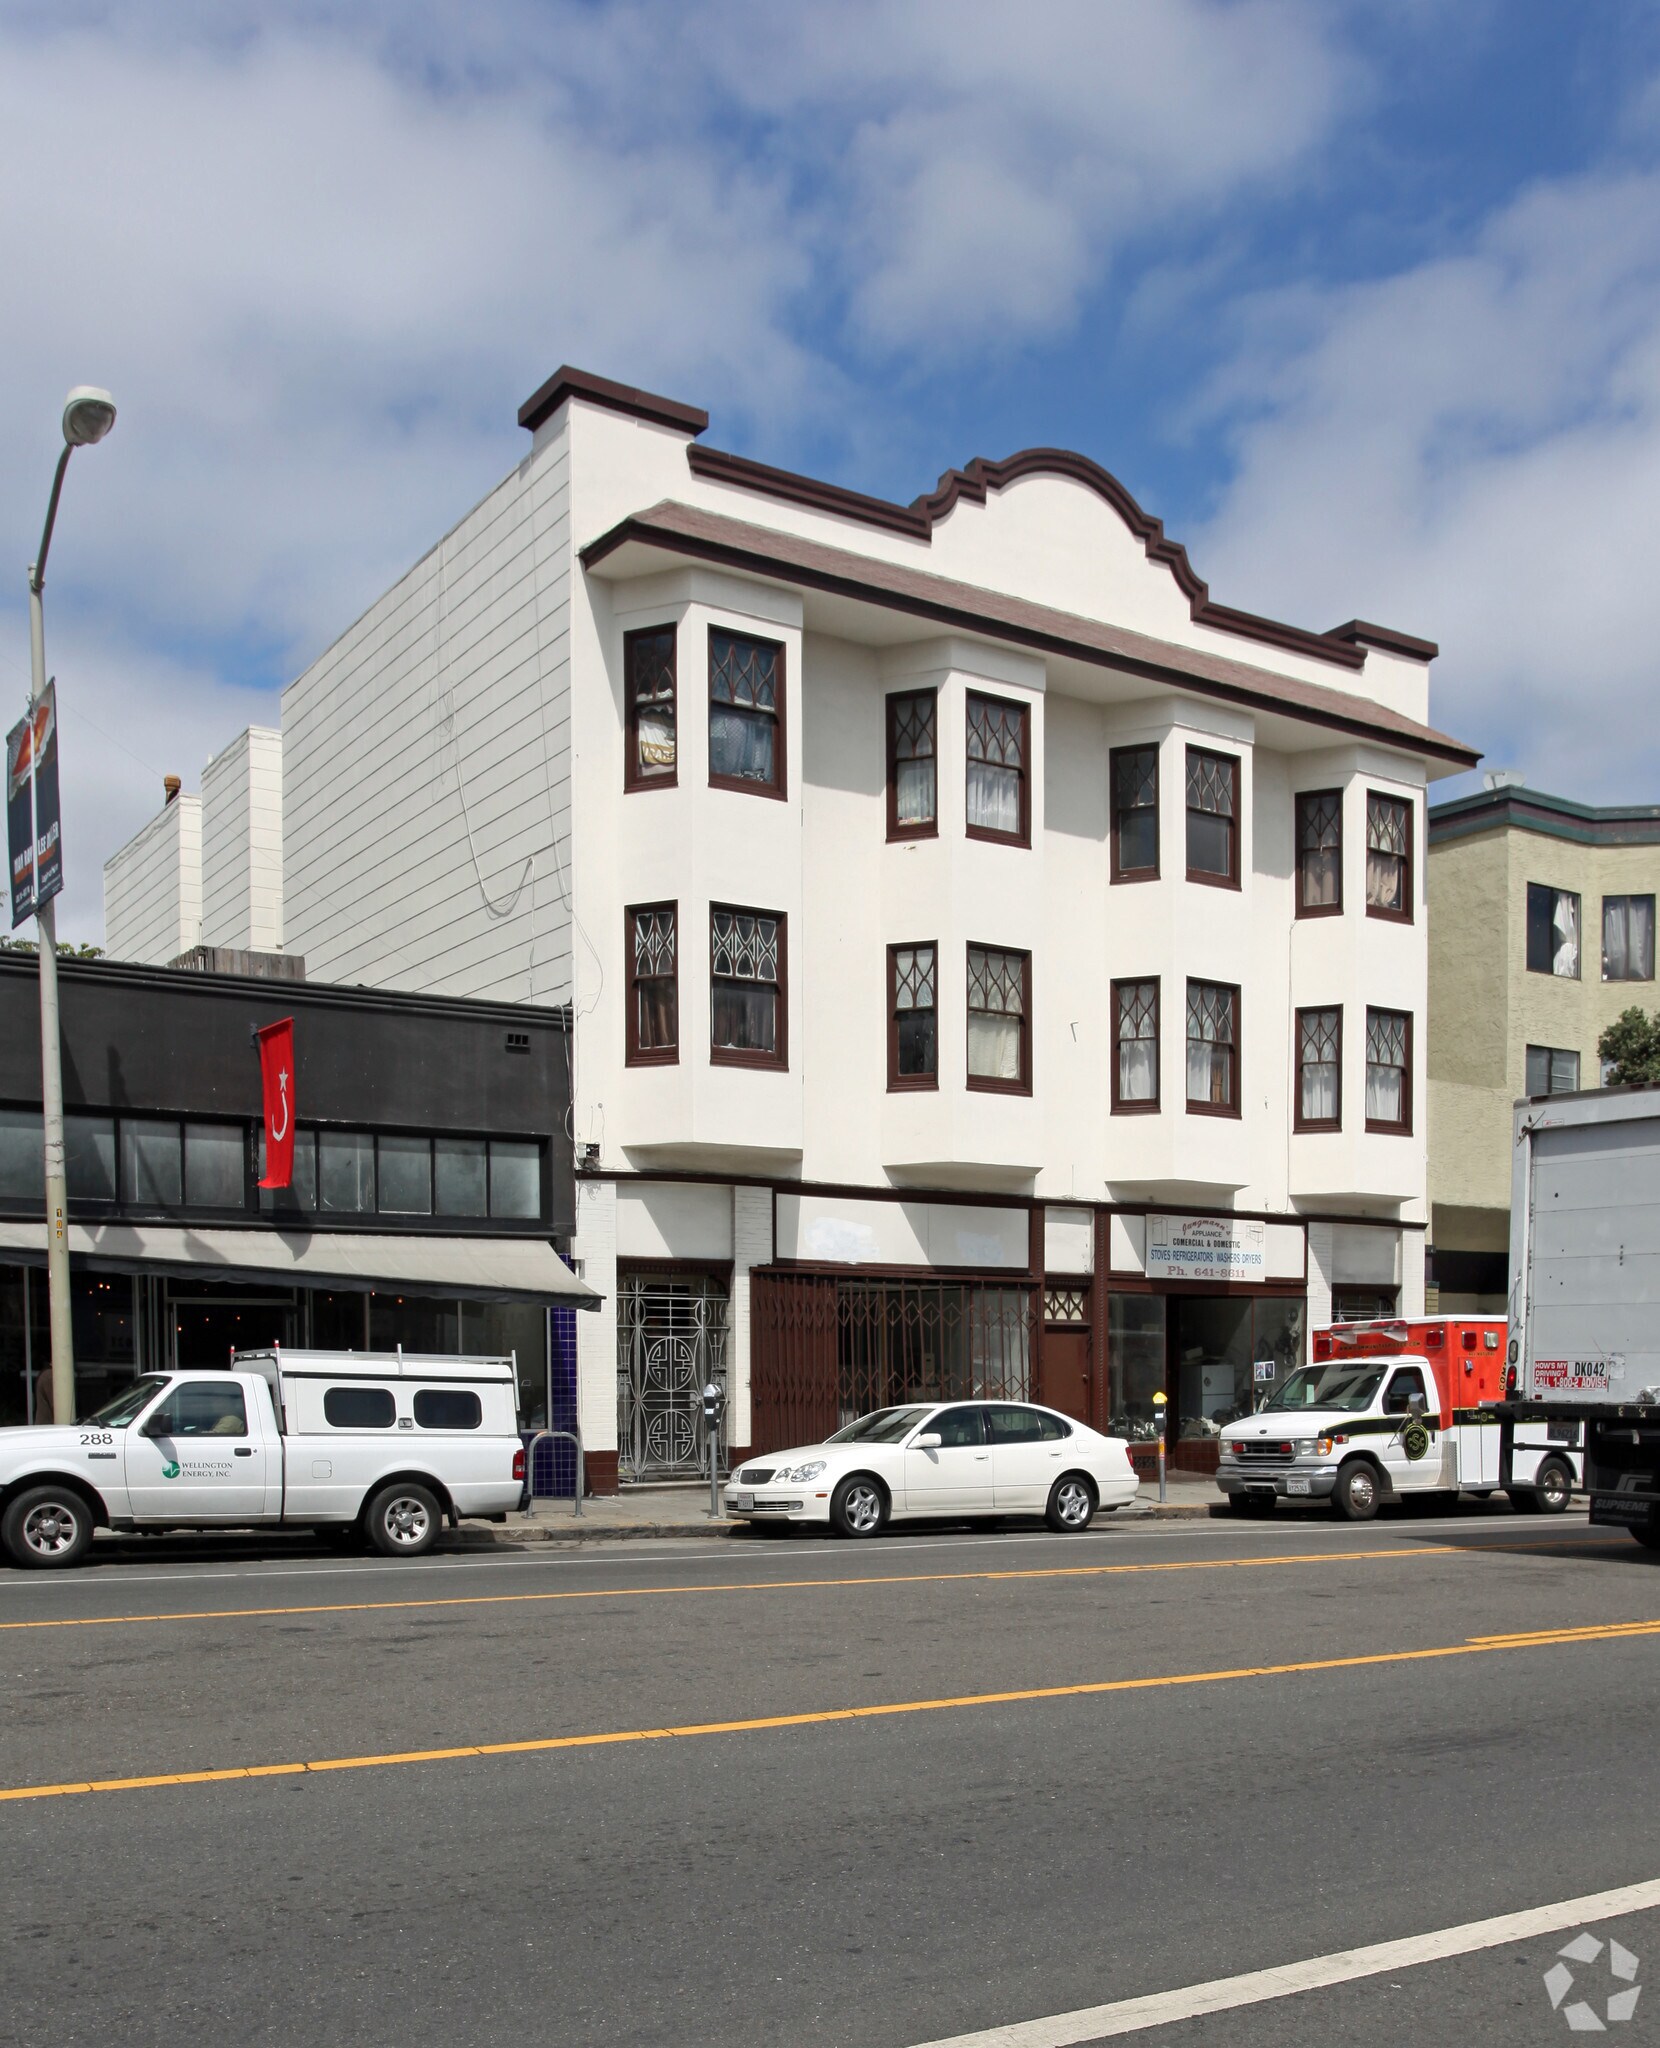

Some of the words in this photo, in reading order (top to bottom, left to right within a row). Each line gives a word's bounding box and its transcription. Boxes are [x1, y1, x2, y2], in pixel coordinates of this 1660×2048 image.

[1192, 1230, 1222, 1238] APPLIANCE
[1172, 1238, 1205, 1248] COMERCIAL
[1207, 1240, 1211, 1248] &
[1213, 1240, 1241, 1249] DOMESTIC
[1150, 1249, 1171, 1260] STOVES
[1173, 1250, 1214, 1262] REFRIGERATORS
[1216, 1251, 1240, 1264] WASHERS
[1241, 1253, 1262, 1265] DRYERS
[1167, 1265, 1188, 1276] Ph.
[1194, 1267, 1246, 1278] 641-8611
[1534, 1377, 1551, 1387] CALL
[1553, 1377, 1579, 1388] 1-800-2
[1581, 1377, 1607, 1389] ADVISE
[80, 1433, 113, 1445] 288
[1595, 1498, 1650, 1512] SUPREME
